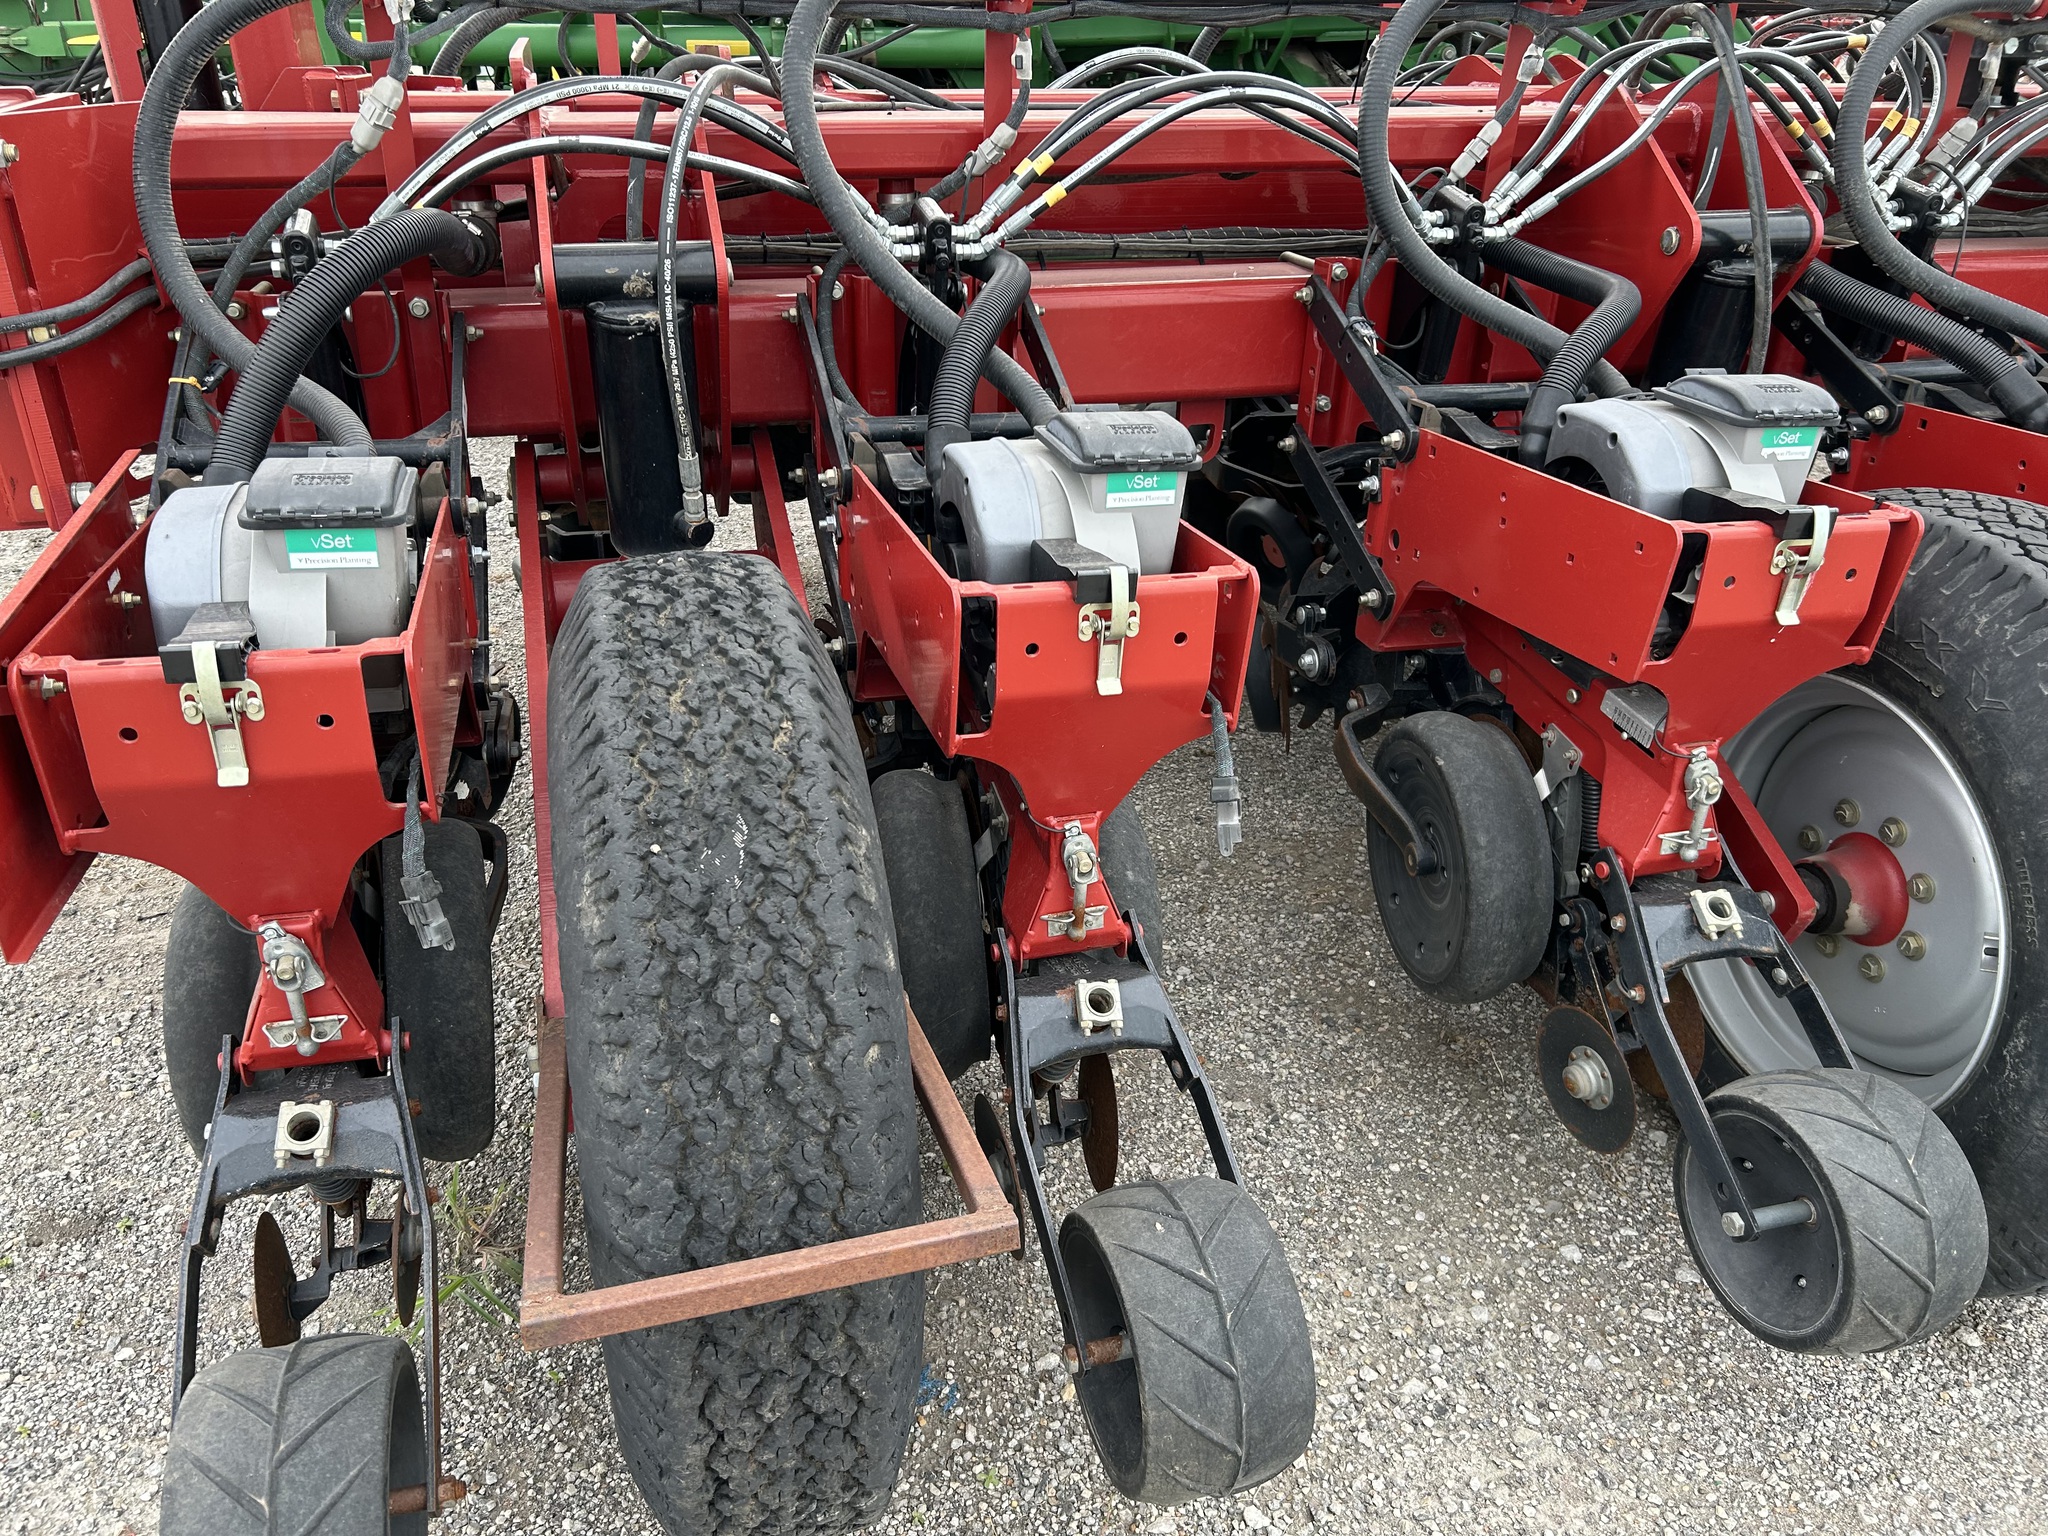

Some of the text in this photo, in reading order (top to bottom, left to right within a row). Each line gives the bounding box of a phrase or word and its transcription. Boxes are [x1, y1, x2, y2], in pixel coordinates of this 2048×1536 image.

[572, 86, 592, 95] (3000
[663, 258, 673, 295] IC-40/26
[666, 294, 674, 320] MSHA
[668, 338, 677, 359] (4250
[672, 359, 680, 376] MPa
[1773, 431, 1803, 445] vSet
[1126, 474, 1158, 489] vSet
[1118, 494, 1171, 503] Precision Planting
[310, 533, 354, 549] vSet
[304, 556, 372, 565] Precision Planting
